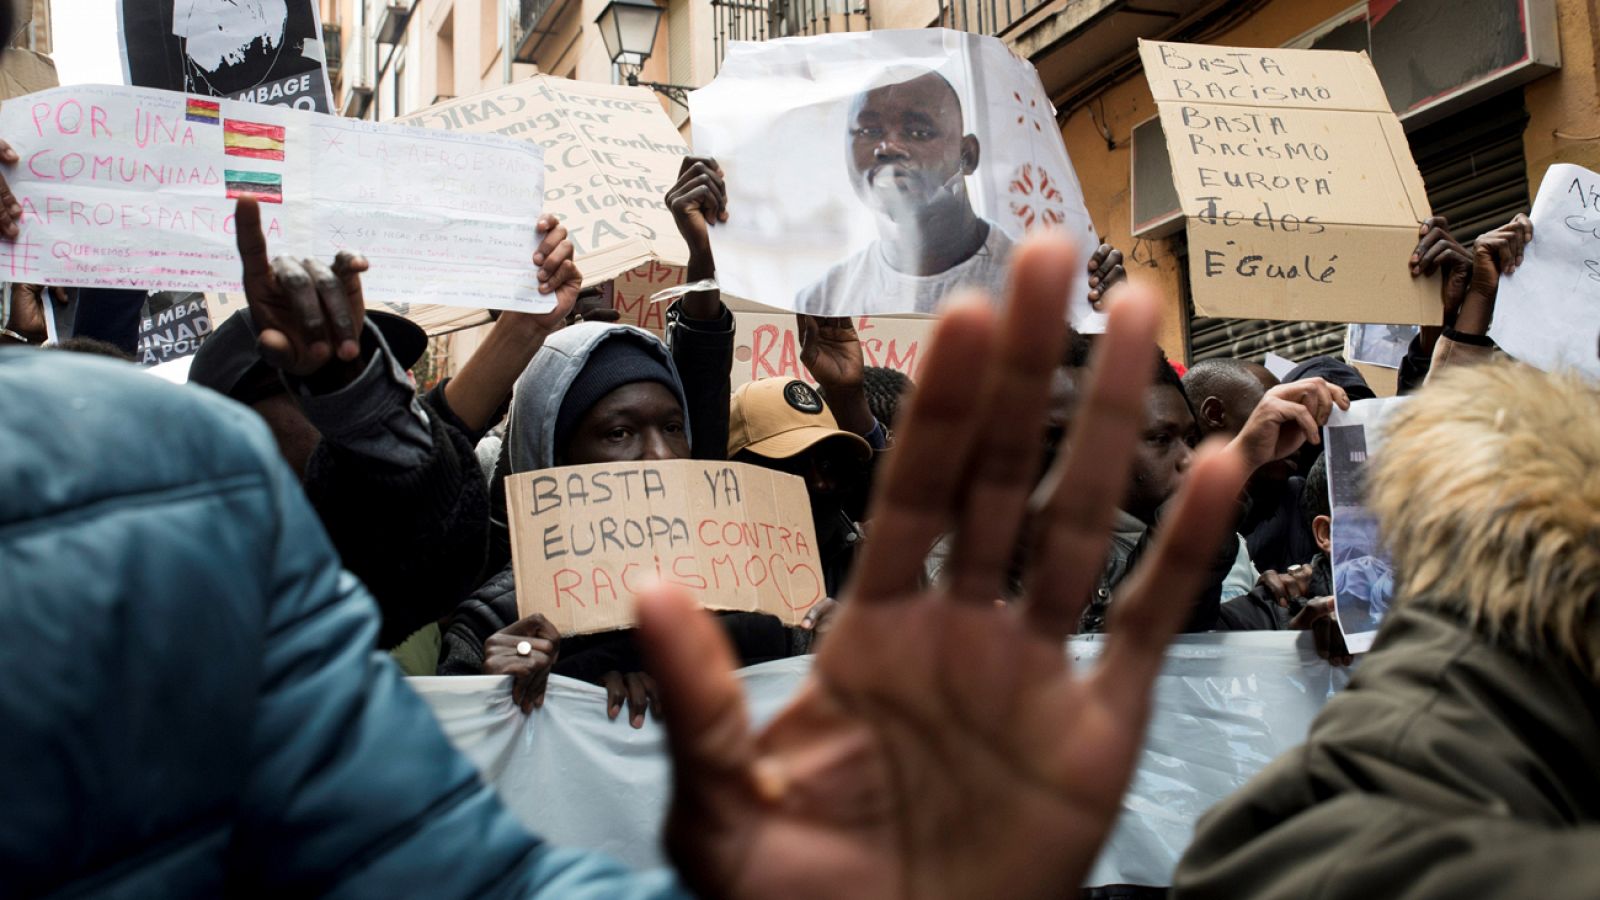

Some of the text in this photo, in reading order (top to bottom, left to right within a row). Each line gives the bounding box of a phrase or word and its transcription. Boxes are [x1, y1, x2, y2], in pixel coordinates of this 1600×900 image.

[1158, 45, 1284, 76] BASTA
[31, 98, 113, 138] POR
[135, 106, 196, 148] UNA
[1181, 106, 1288, 136] BASTA
[28, 148, 220, 185] COMUNIDAD
[531, 467, 741, 516] BASTA YA
[543, 515, 811, 561] EUROPA CONTRA
